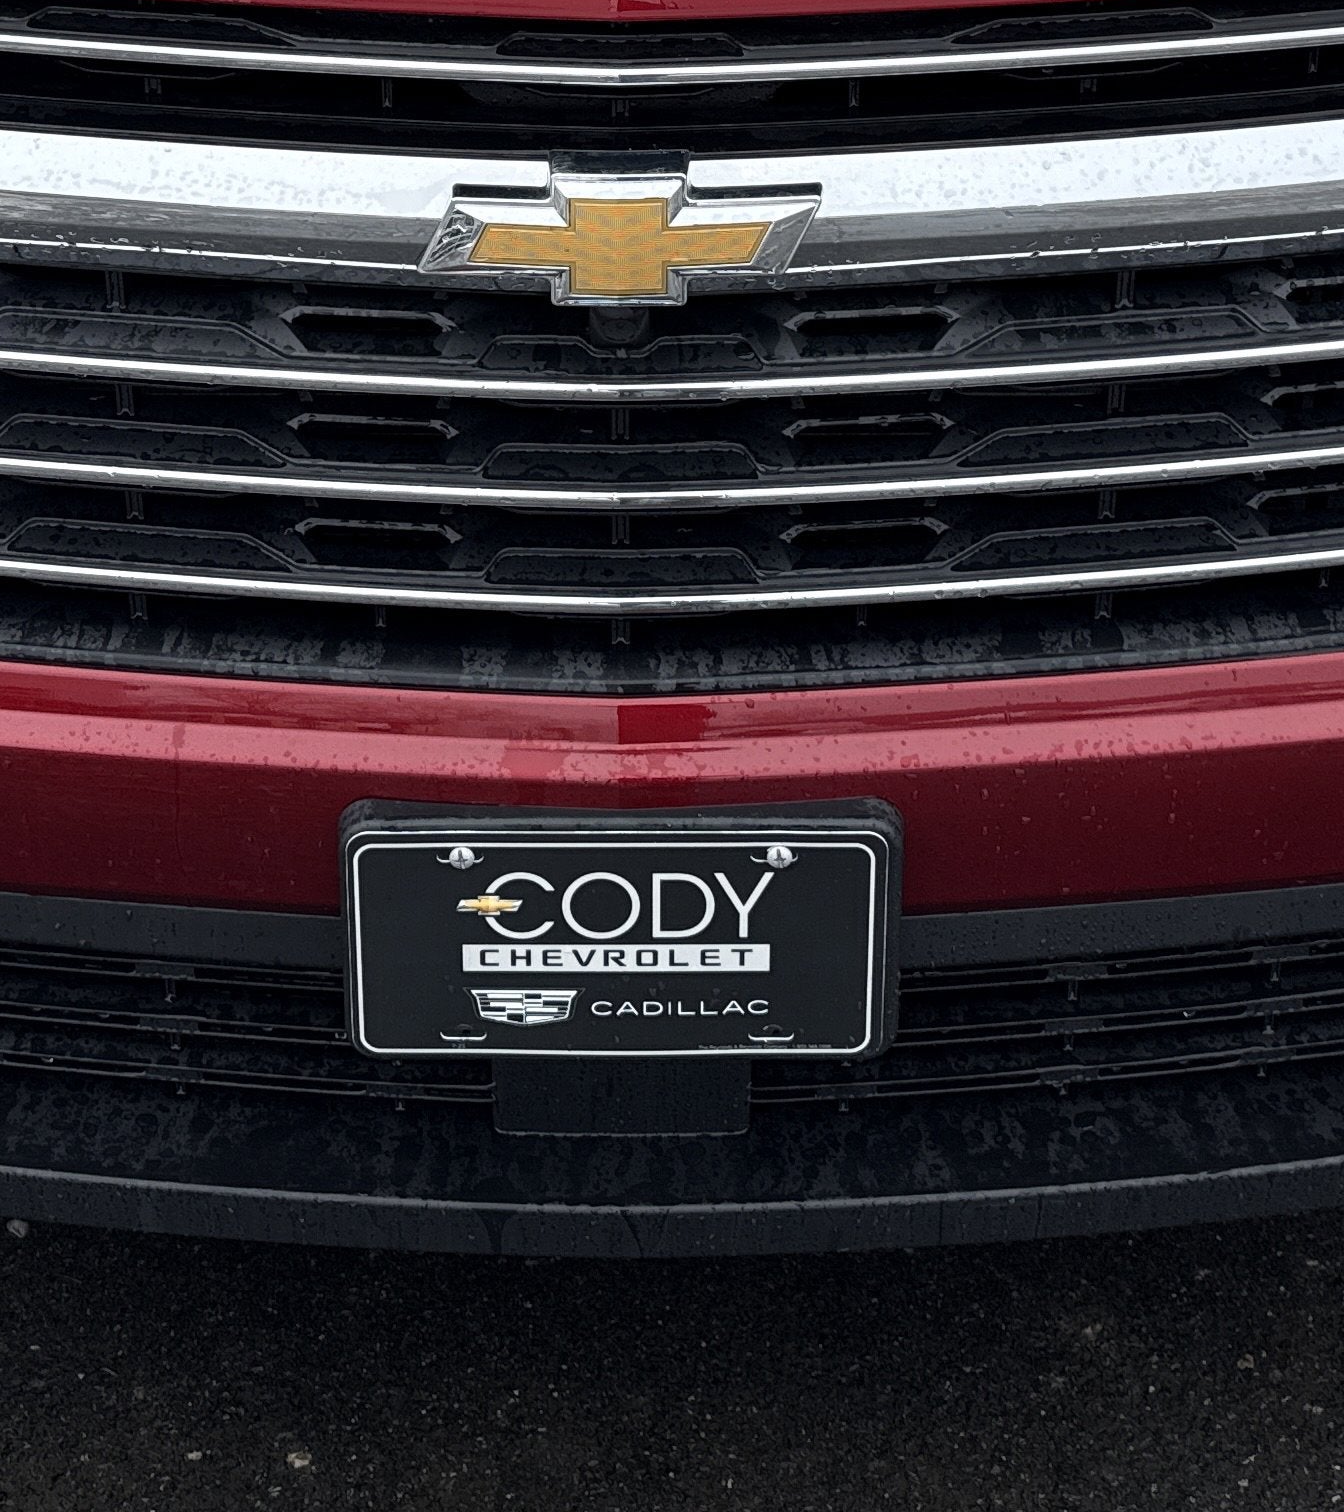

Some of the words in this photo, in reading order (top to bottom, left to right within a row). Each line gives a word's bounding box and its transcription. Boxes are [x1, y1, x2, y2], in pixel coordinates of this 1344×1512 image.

[483, 871, 774, 940] CODY
[479, 947, 755, 968] CHEVROLET
[590, 999, 770, 1017] CADILLAC
